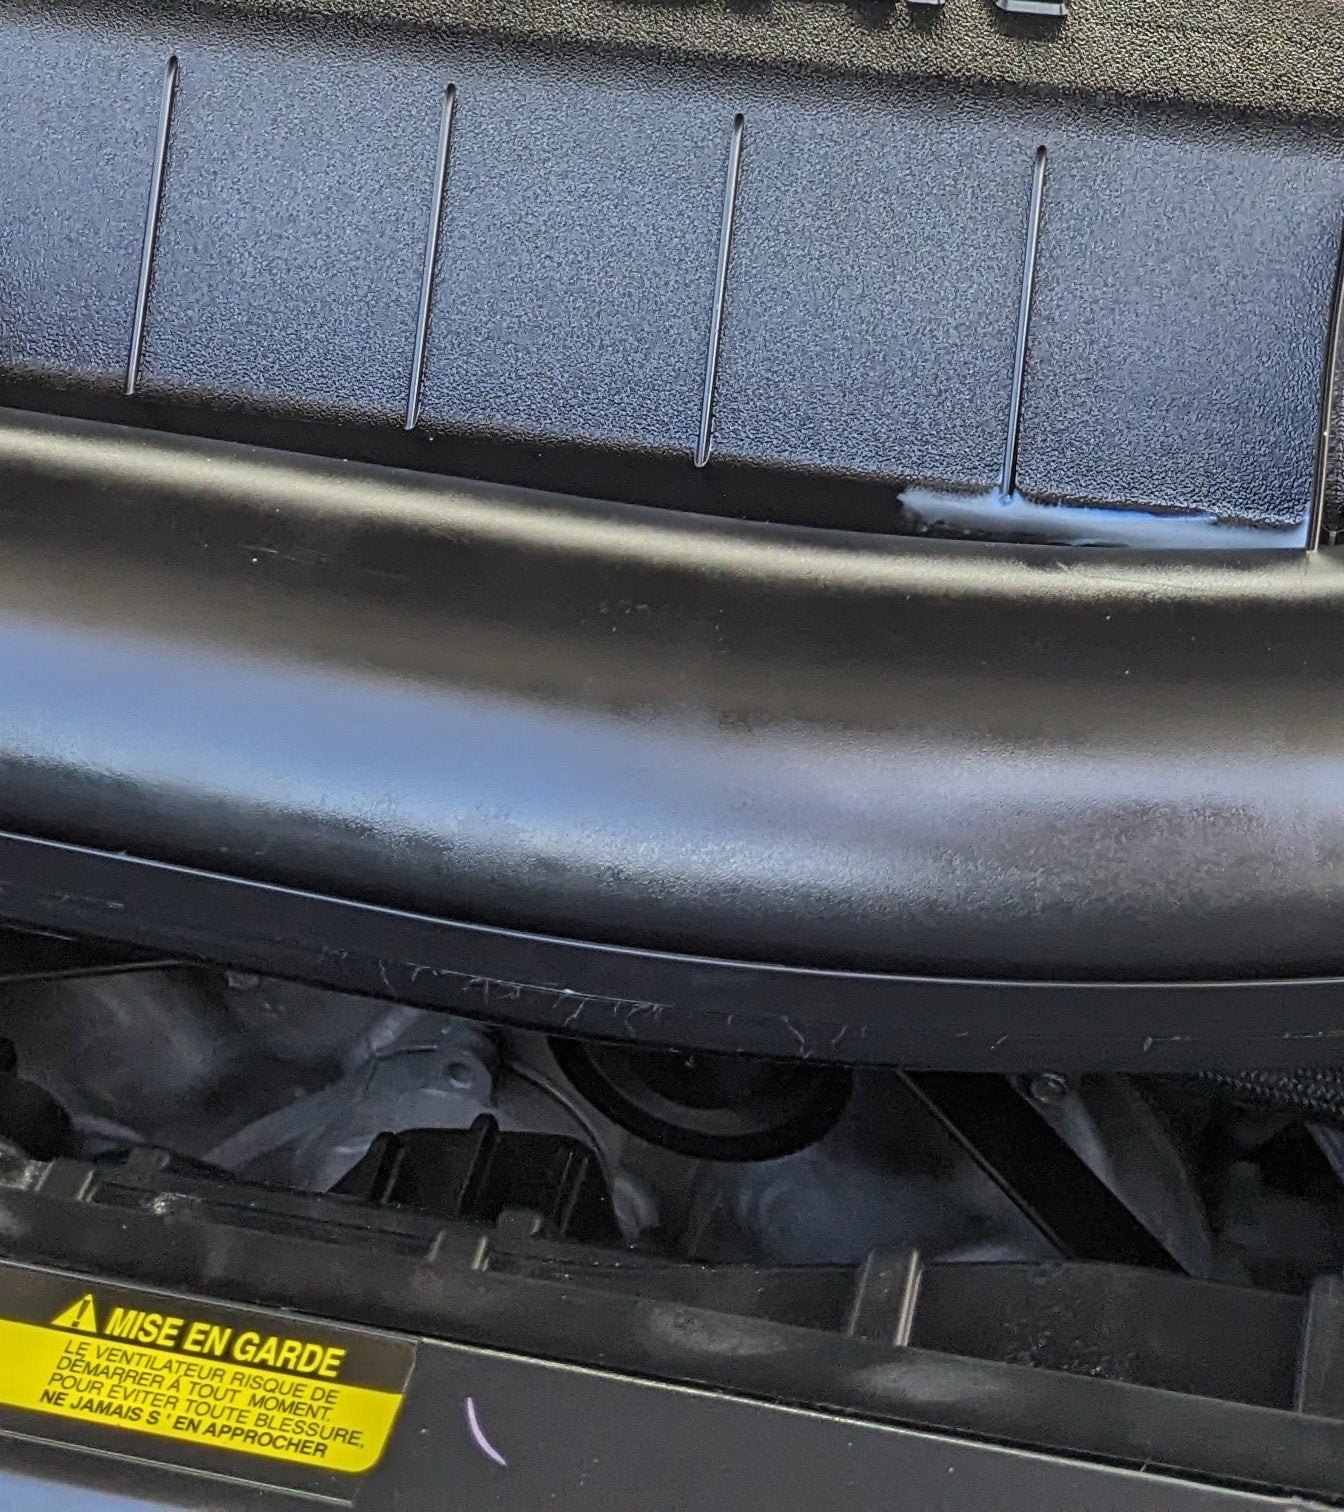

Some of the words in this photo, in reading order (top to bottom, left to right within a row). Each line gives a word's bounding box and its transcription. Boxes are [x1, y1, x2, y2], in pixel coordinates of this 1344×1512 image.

[64, 1339, 90, 1356] LE
[94, 1345, 226, 1384] VENTILATEUR
[230, 1372, 307, 1401] RISQUE
[310, 1387, 340, 1405] DE
[105, 1308, 184, 1347] MISE
[183, 1322, 232, 1356] EN
[233, 1331, 347, 1377] GARDE
[40, 1389, 66, 1407] NE
[69, 1396, 143, 1422] JAMAIS
[203, 1422, 329, 1459] APPROCHER
[48, 1373, 105, 1395] POUR
[186, 1398, 250, 1426] TOUTE
[254, 1412, 366, 1449] BLESSURE,
[188, 1380, 242, 1404] TOUT
[248, 1393, 332, 1422] MOMENT.
